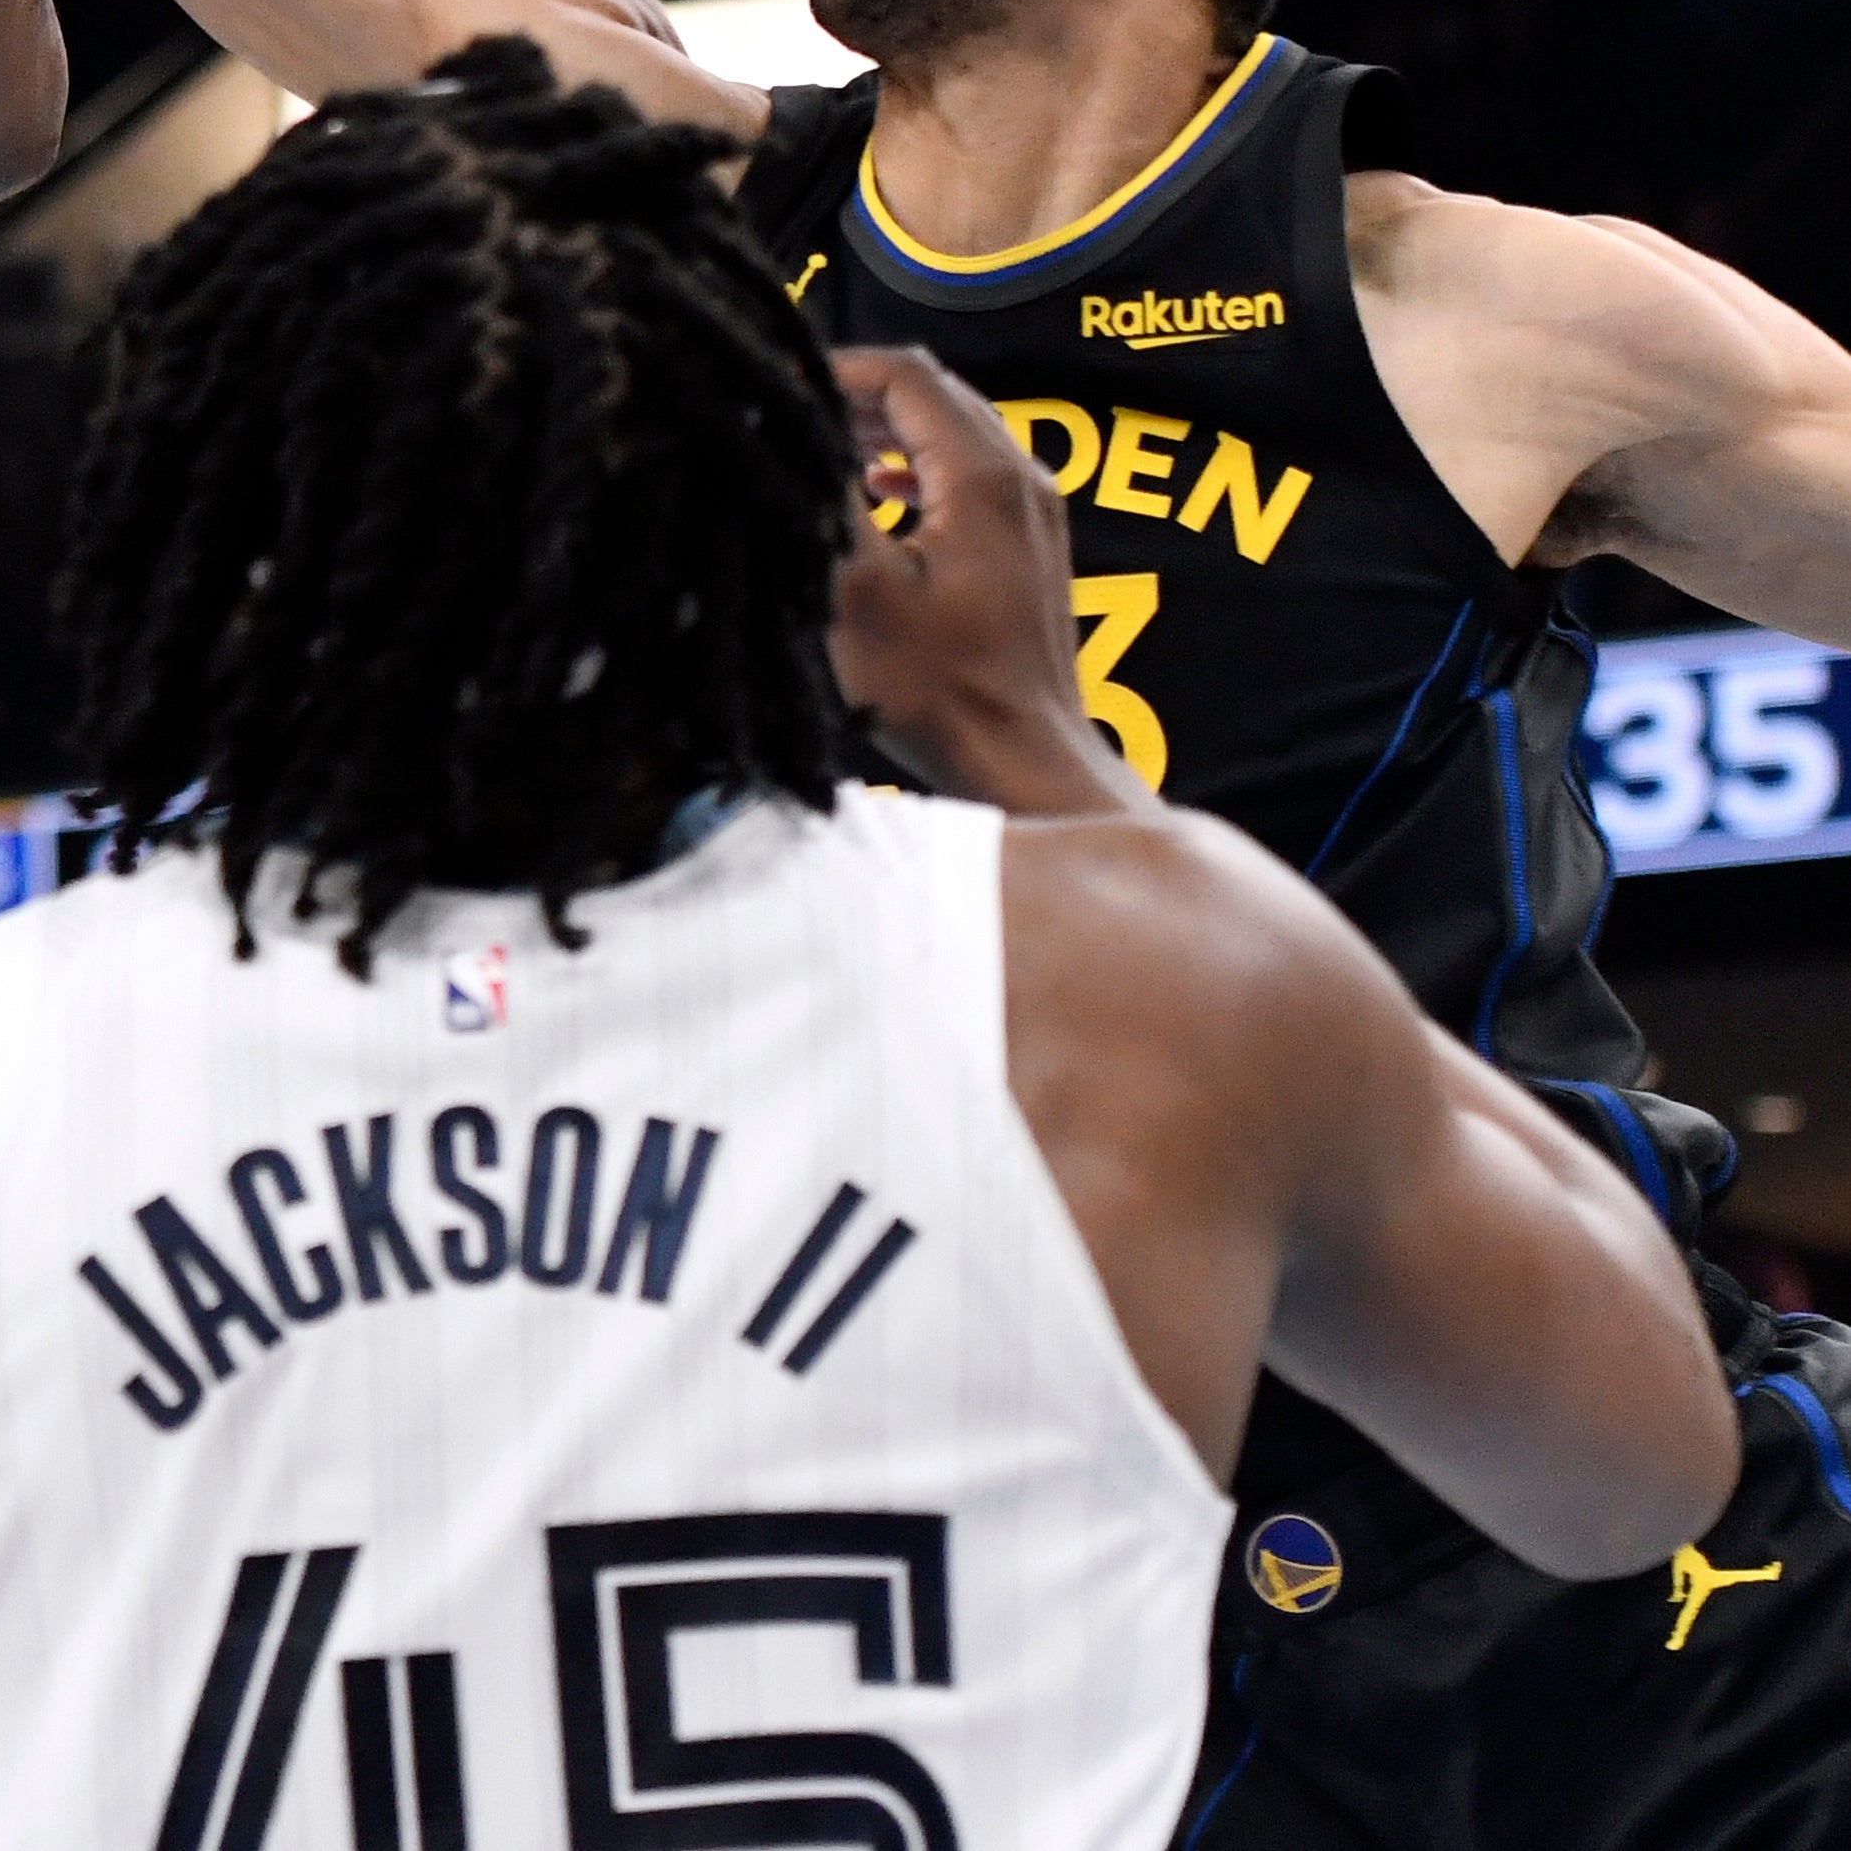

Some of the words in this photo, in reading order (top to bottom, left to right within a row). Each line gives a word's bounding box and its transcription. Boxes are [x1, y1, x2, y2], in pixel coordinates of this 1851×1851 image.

[1081, 290, 1286, 339] Rakuten
[992, 398, 1314, 566] DEN
[1583, 666, 1841, 846] 35
[79, 1104, 718, 1432] JACKSON
[742, 1182, 915, 1375] II
[152, 1509, 962, 1851] 45
